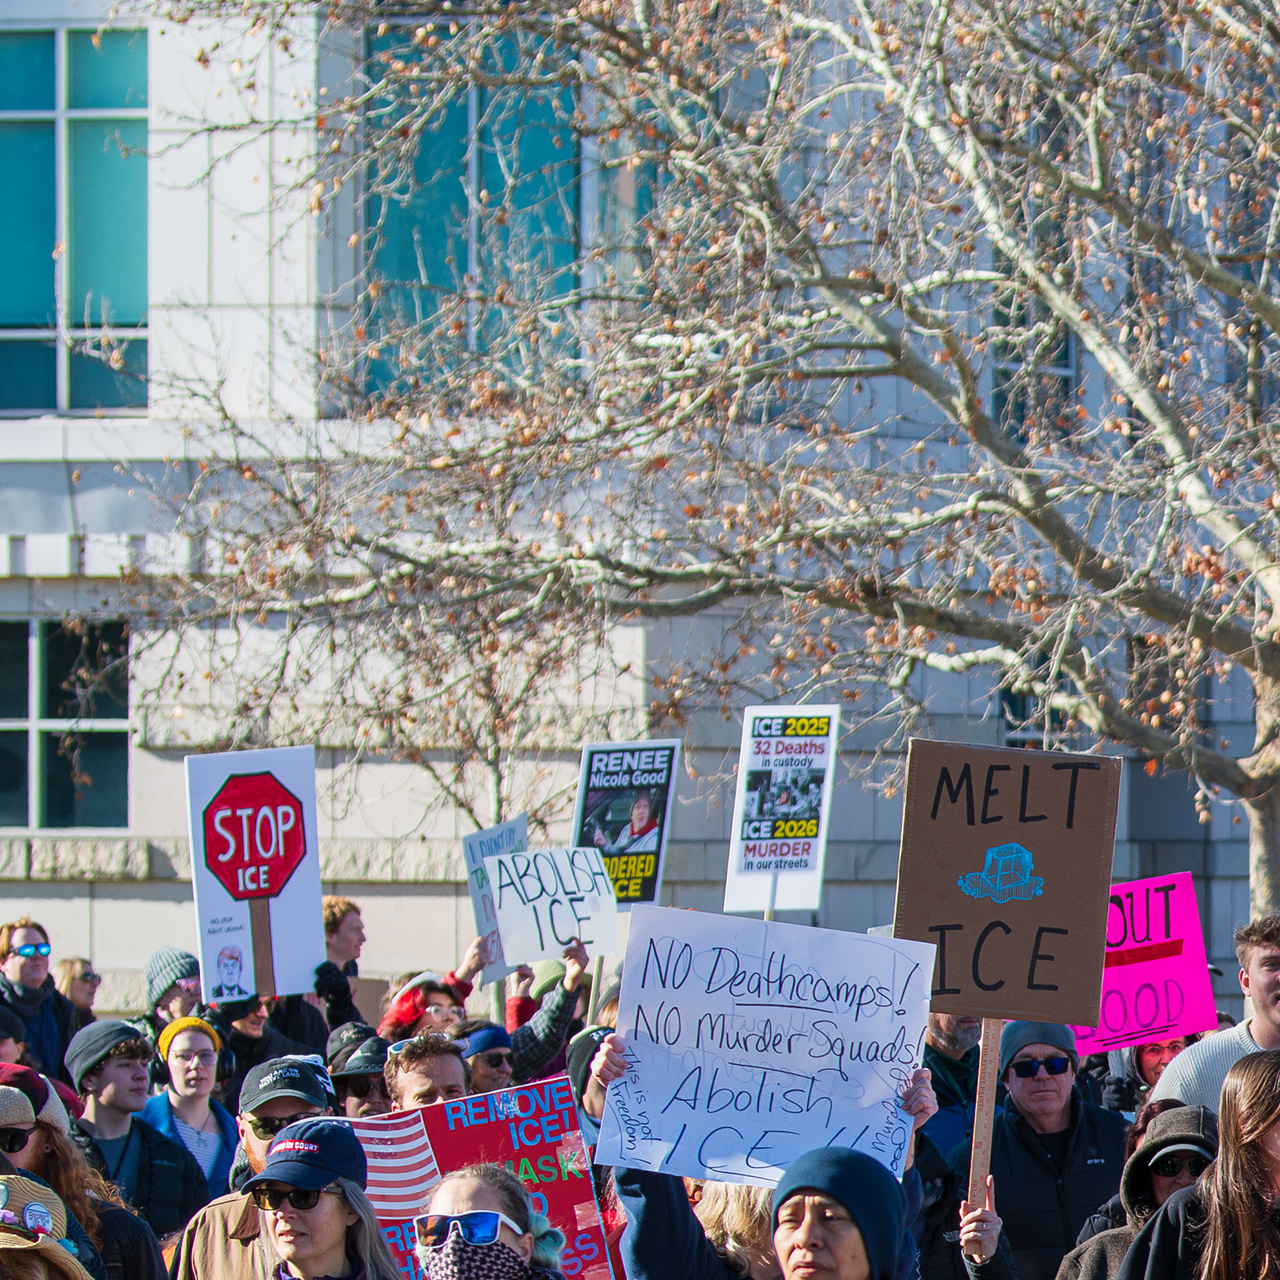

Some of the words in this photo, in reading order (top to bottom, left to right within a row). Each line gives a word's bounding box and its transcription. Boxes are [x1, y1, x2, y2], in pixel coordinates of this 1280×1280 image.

[753, 718, 783, 736] ICE
[785, 717, 829, 736] 2025
[590, 749, 670, 772] RENEE
[753, 741, 771, 756] 32
[774, 740, 825, 756] Deaths
[761, 756, 770, 768] in
[773, 755, 814, 769] custody
[589, 771, 630, 788] Nicole
[631, 768, 667, 785] Good
[930, 762, 1101, 830] MELT
[213, 805, 296, 863] STOP
[742, 820, 772, 840] ICE
[773, 819, 818, 838] 2026
[743, 841, 812, 858] MURDER
[237, 864, 270, 892] ICE
[497, 848, 611, 910] ABOLISH
[743, 858, 753, 871] in
[755, 859, 773, 870] our
[773, 857, 809, 870] streets
[532, 895, 594, 951] ICE
[928, 920, 1069, 997] ICE
[641, 937, 692, 990] NO
[704, 947, 920, 1023] Deathcamps!
[634, 1000, 682, 1046] NO
[696, 1013, 812, 1055] Murder
[444, 1080, 574, 1131] REMOVE
[661, 1065, 834, 1129] Abolish
[508, 1110, 572, 1150] ICE!
